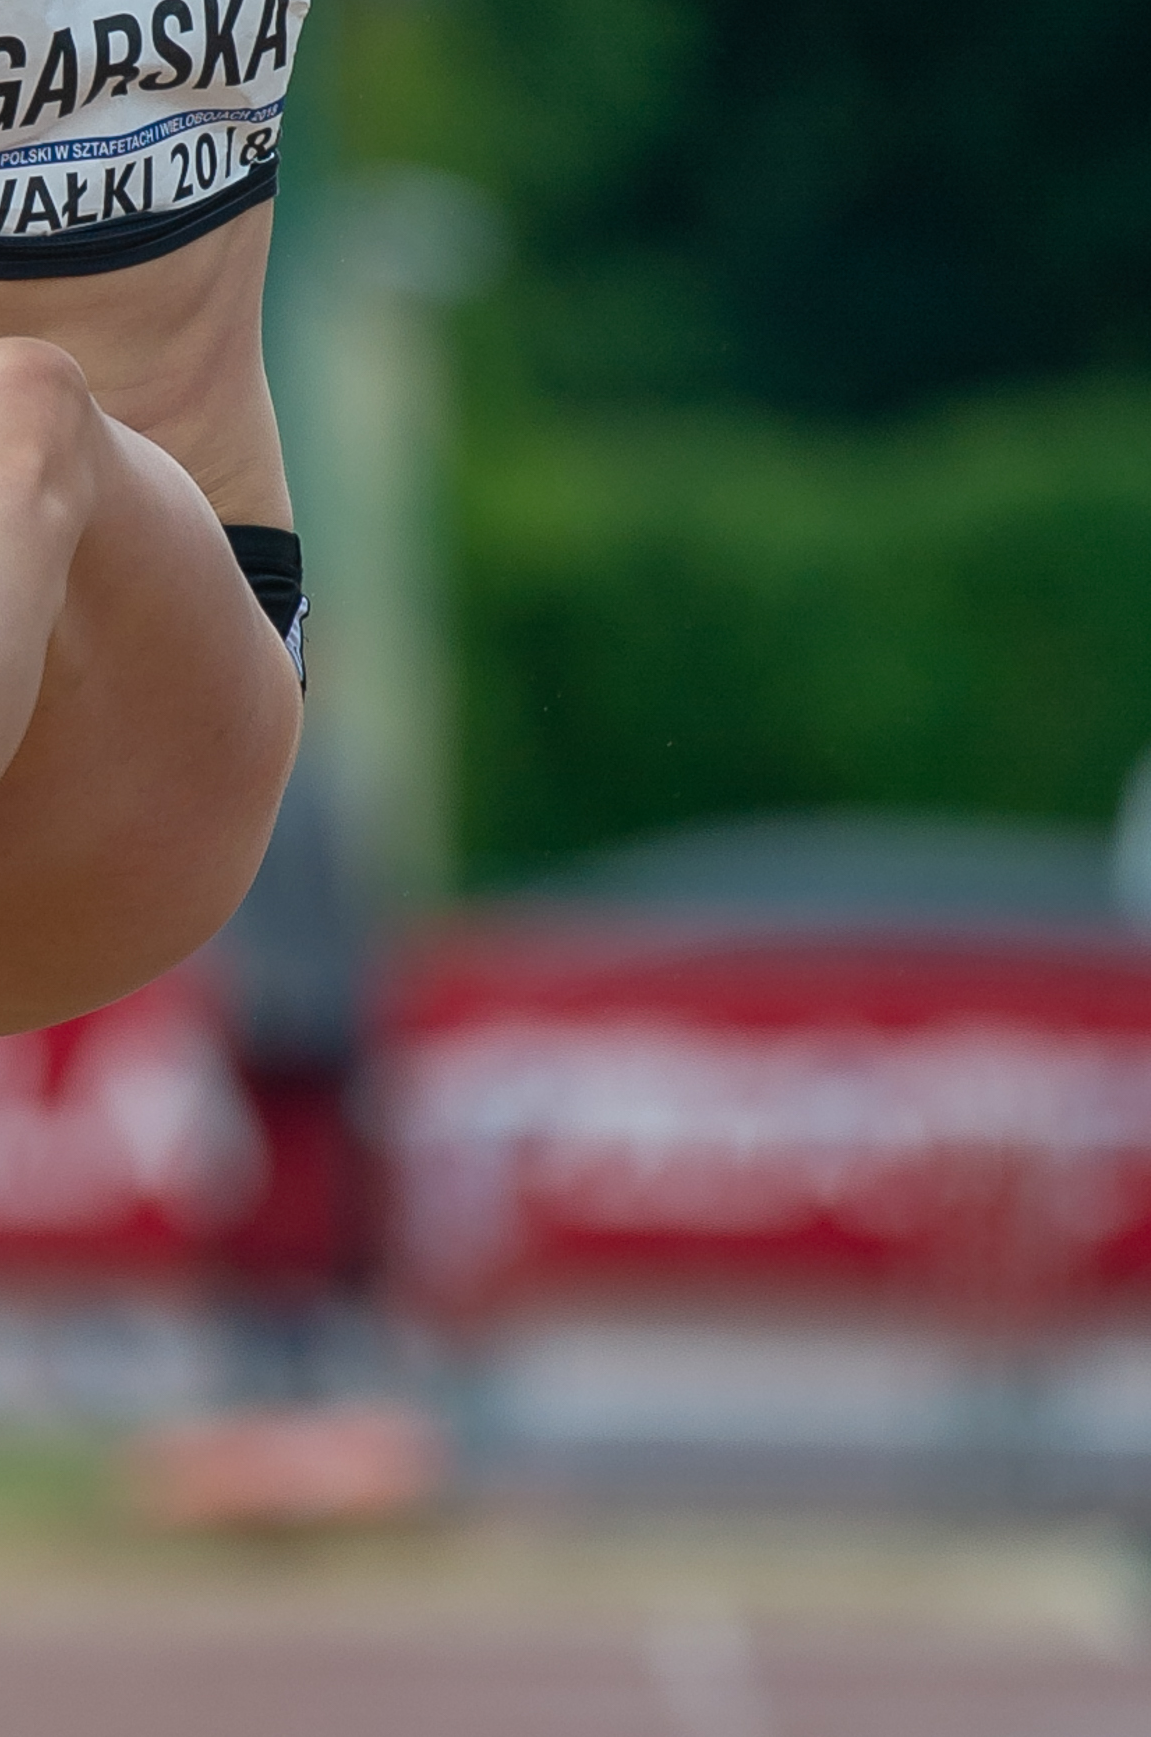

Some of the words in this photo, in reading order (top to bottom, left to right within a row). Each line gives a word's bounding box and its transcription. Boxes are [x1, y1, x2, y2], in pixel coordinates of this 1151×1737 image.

[0, 144, 52, 167] POLSKI
[54, 143, 71, 161] W
[72, 128, 154, 159] SZTAFETACH
[170, 126, 274, 203] 2018
